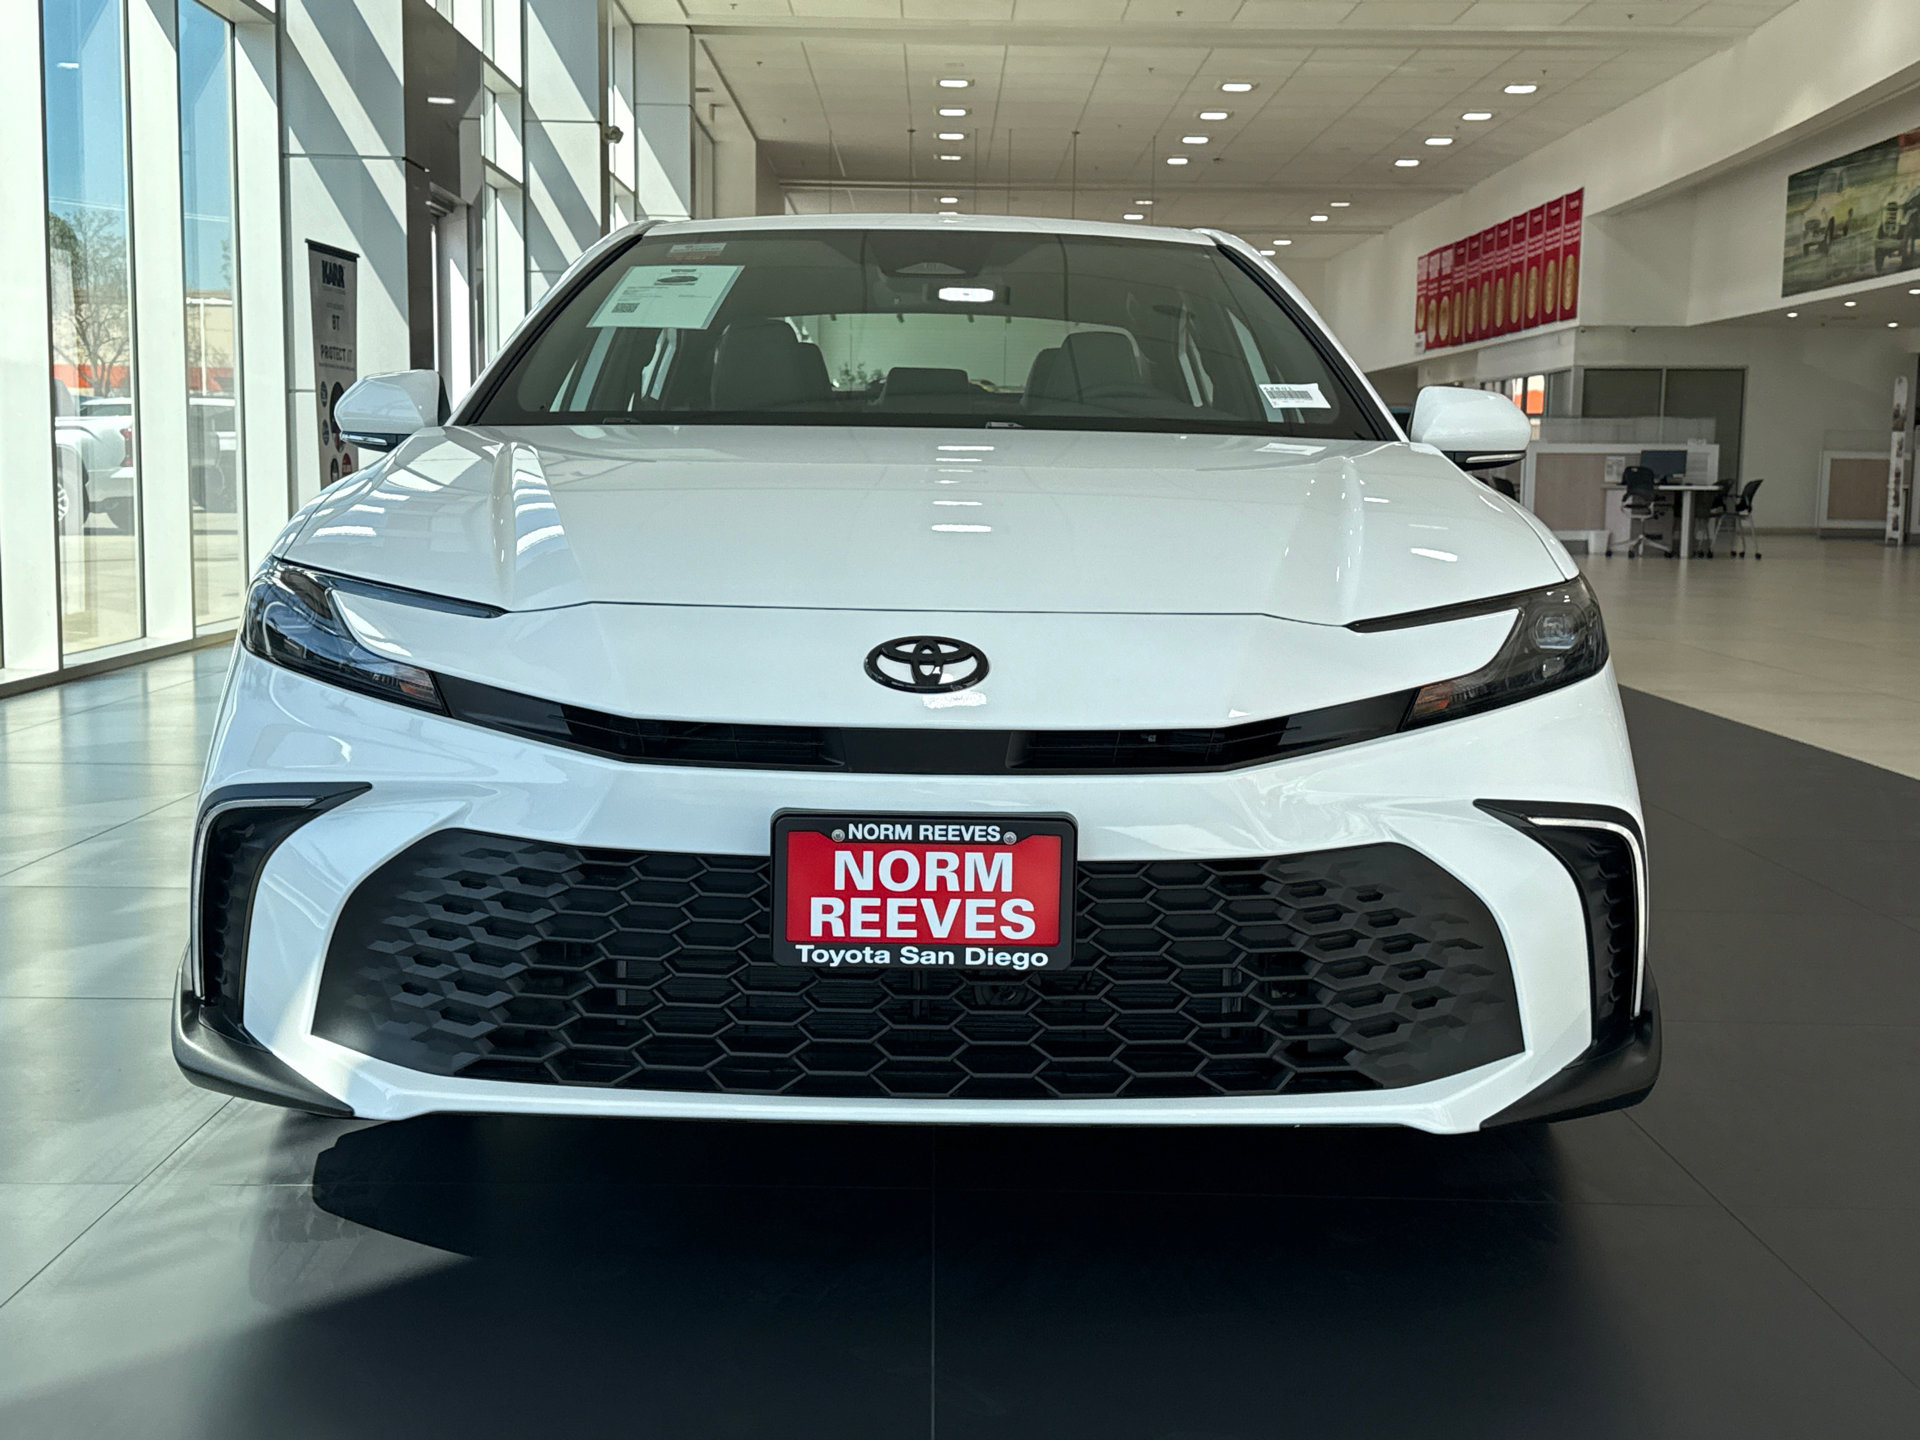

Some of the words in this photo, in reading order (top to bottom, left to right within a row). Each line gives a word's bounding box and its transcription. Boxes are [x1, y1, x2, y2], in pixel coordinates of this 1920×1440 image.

[322, 260, 345, 288] KARR
[320, 344, 346, 362] PROTECT
[848, 823, 912, 841] NORM
[919, 825, 1001, 842] REEVES
[834, 850, 1013, 892] NORM
[810, 897, 1036, 940] REEVES
[795, 944, 891, 968] Toyota
[899, 946, 955, 965] San
[965, 947, 1049, 970] Diego
